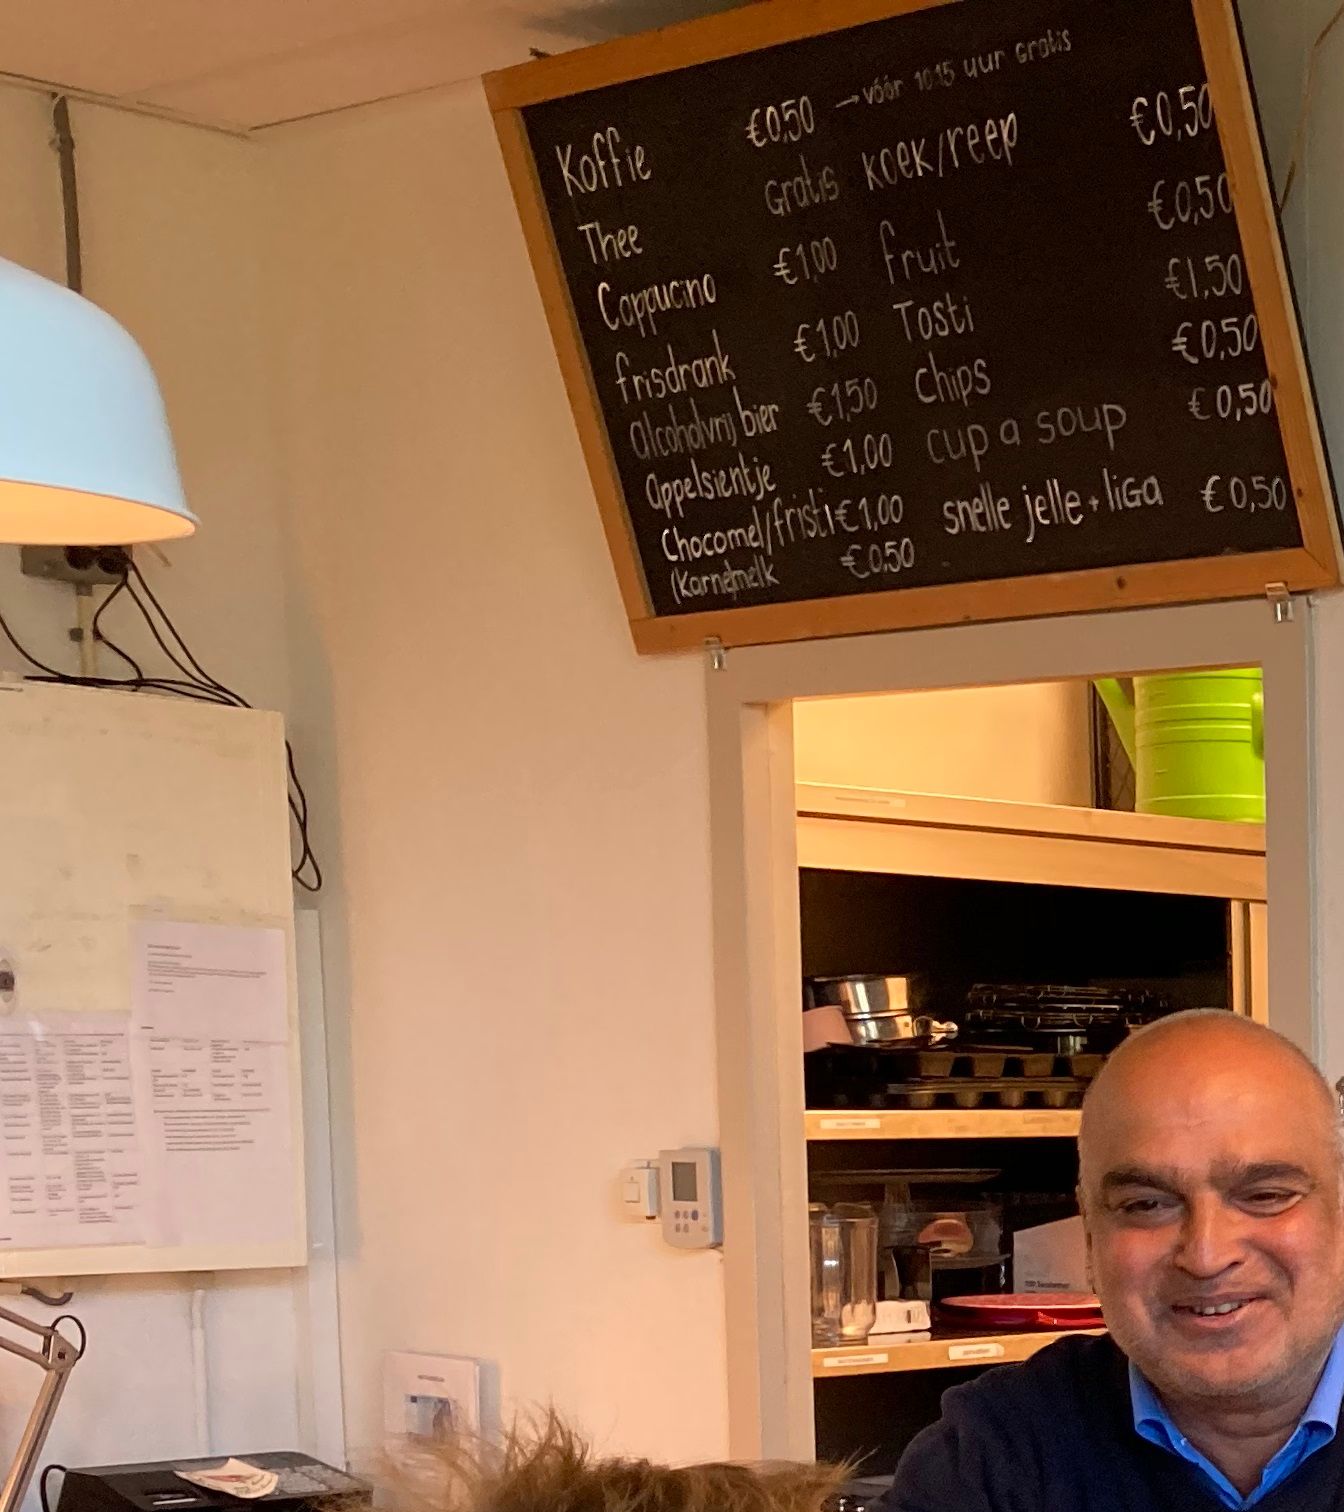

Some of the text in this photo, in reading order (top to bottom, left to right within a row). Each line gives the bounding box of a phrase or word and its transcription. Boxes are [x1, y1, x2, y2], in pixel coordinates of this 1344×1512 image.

[555, 126, 652, 198] Koffie
[577, 219, 643, 265] Thee
[893, 292, 975, 343] Tosti
[732, 385, 780, 437] bier
